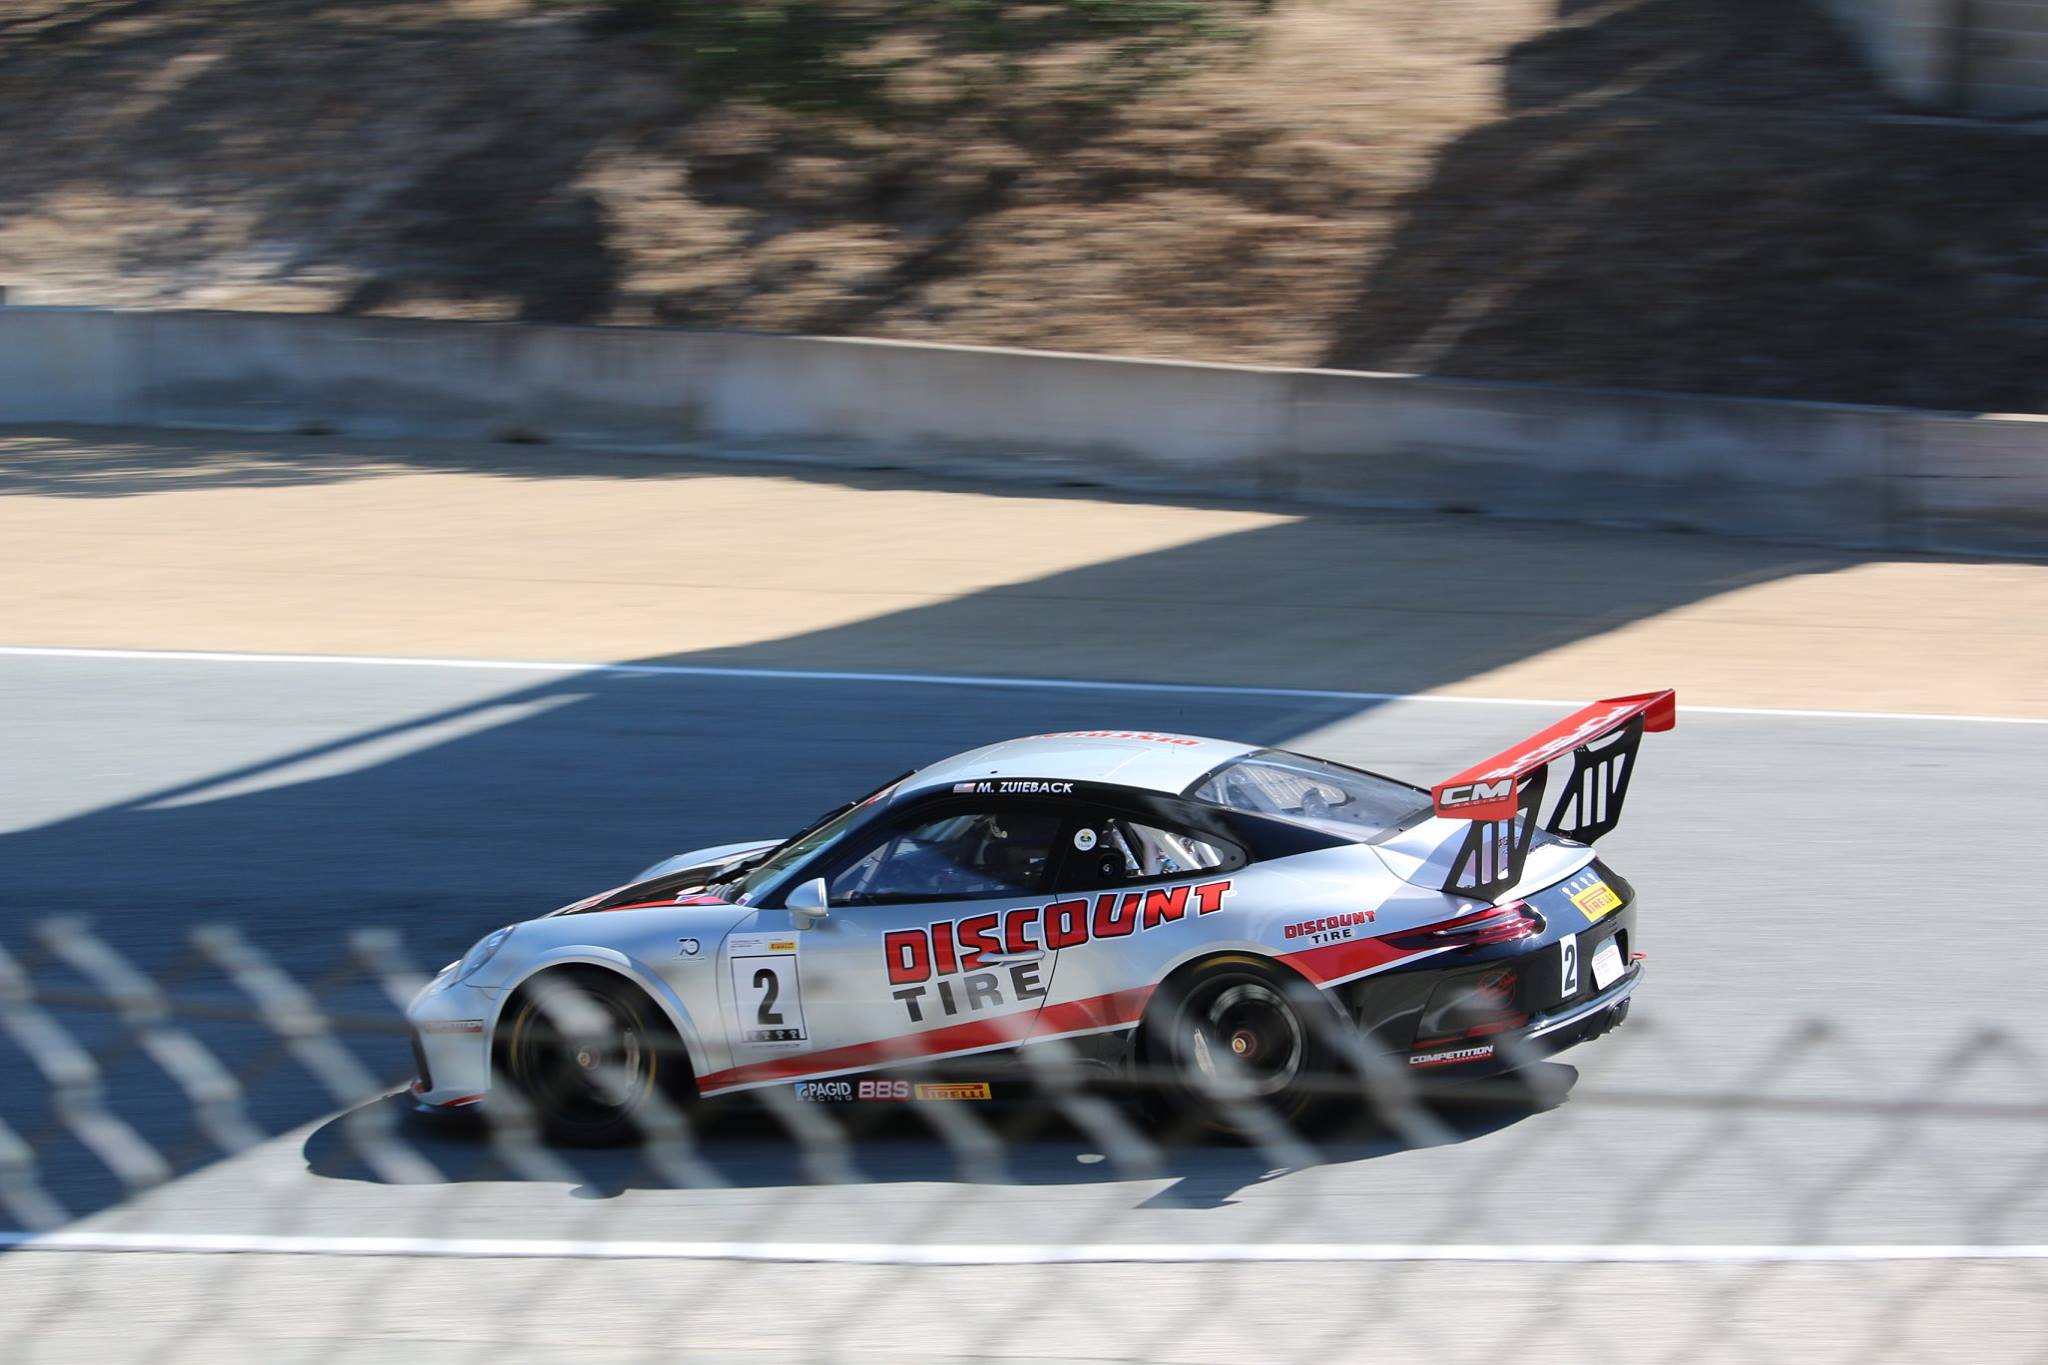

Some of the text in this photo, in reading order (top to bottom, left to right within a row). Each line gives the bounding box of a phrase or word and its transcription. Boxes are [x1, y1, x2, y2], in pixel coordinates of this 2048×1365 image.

[977, 782, 1073, 793] M. ZUIEBACK
[1441, 780, 1513, 805] CM
[884, 879, 1231, 985] DISCOUNT
[1284, 911, 1375, 938] DISCOUNT
[1312, 929, 1352, 943] TIRE
[1565, 944, 1576, 991] 2
[753, 968, 784, 1025] 2
[893, 963, 1046, 1023] TIRE
[1410, 1045, 1494, 1064] COMPETITION
[808, 1082, 851, 1096] PAGID
[859, 1081, 908, 1098] BBS
